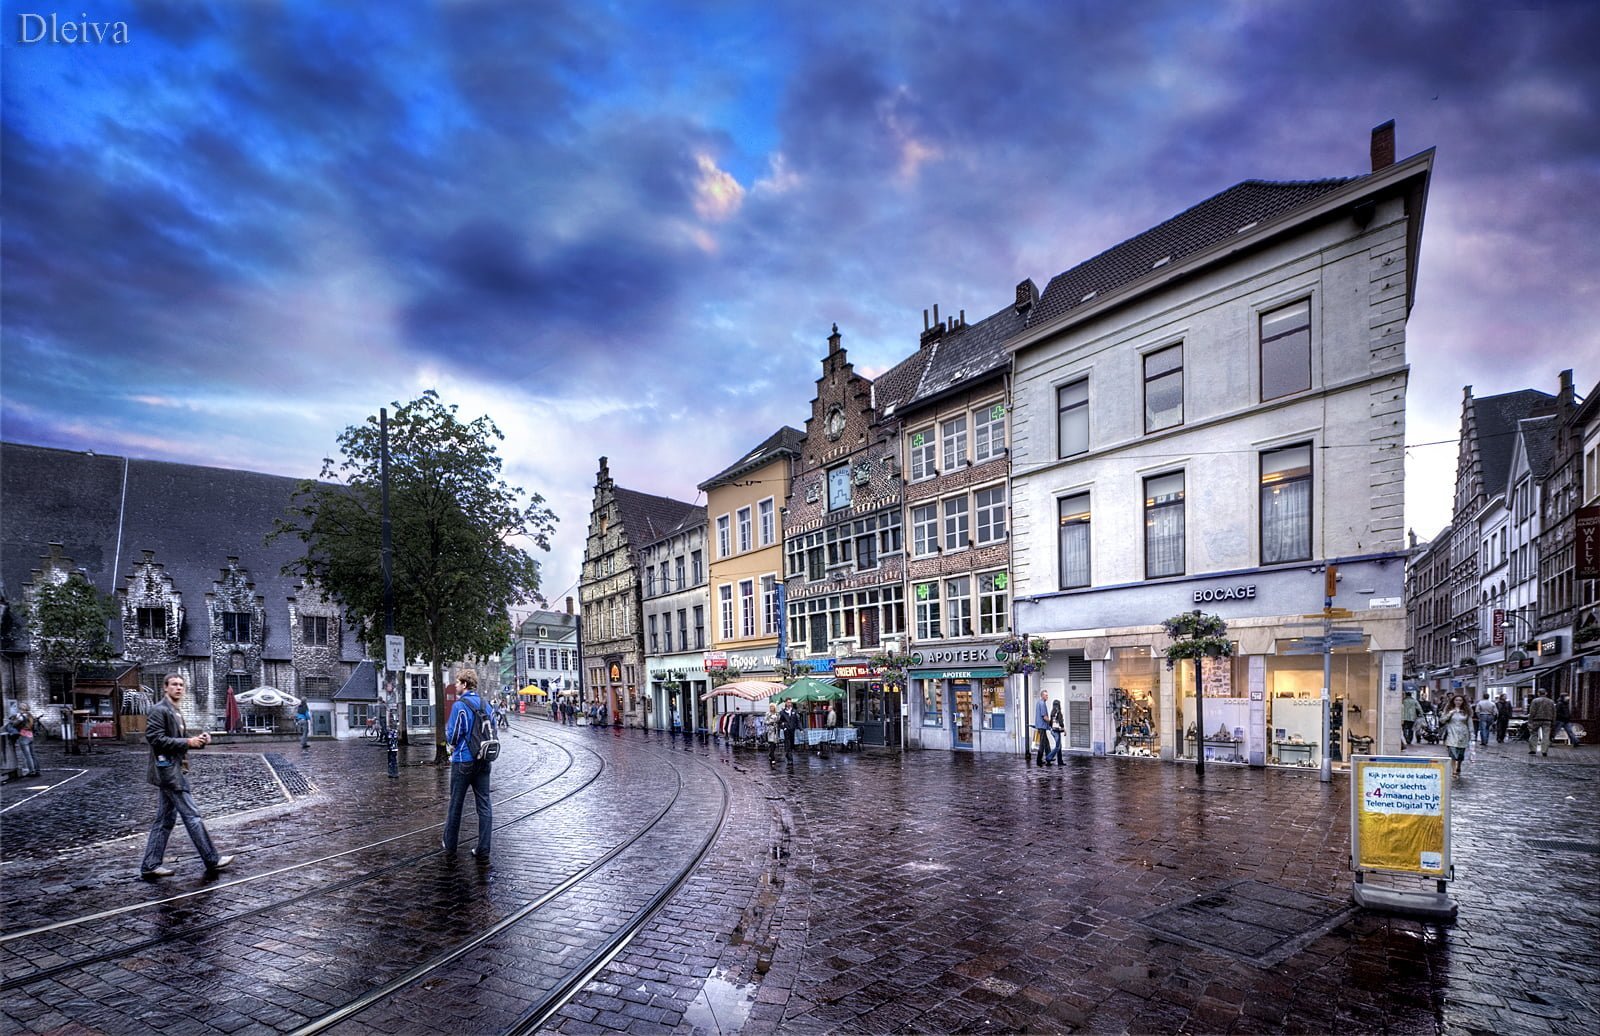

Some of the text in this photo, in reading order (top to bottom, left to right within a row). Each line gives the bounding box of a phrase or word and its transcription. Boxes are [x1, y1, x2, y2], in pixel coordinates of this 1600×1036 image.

[1583, 527, 1595, 565] WALLY
[1193, 584, 1257, 603] BOCAGE
[730, 654, 759, 670] Rogge
[928, 649, 988, 663] APOTEEK
[835, 666, 858, 678] ORIENT
[942, 671, 972, 679] APOTEEK
[1400, 782, 1427, 790] slechts
[1415, 793, 1431, 801] heb
[1432, 793, 1440, 802] je
[1366, 799, 1394, 808] Telenet
[1396, 801, 1423, 810] Digital
